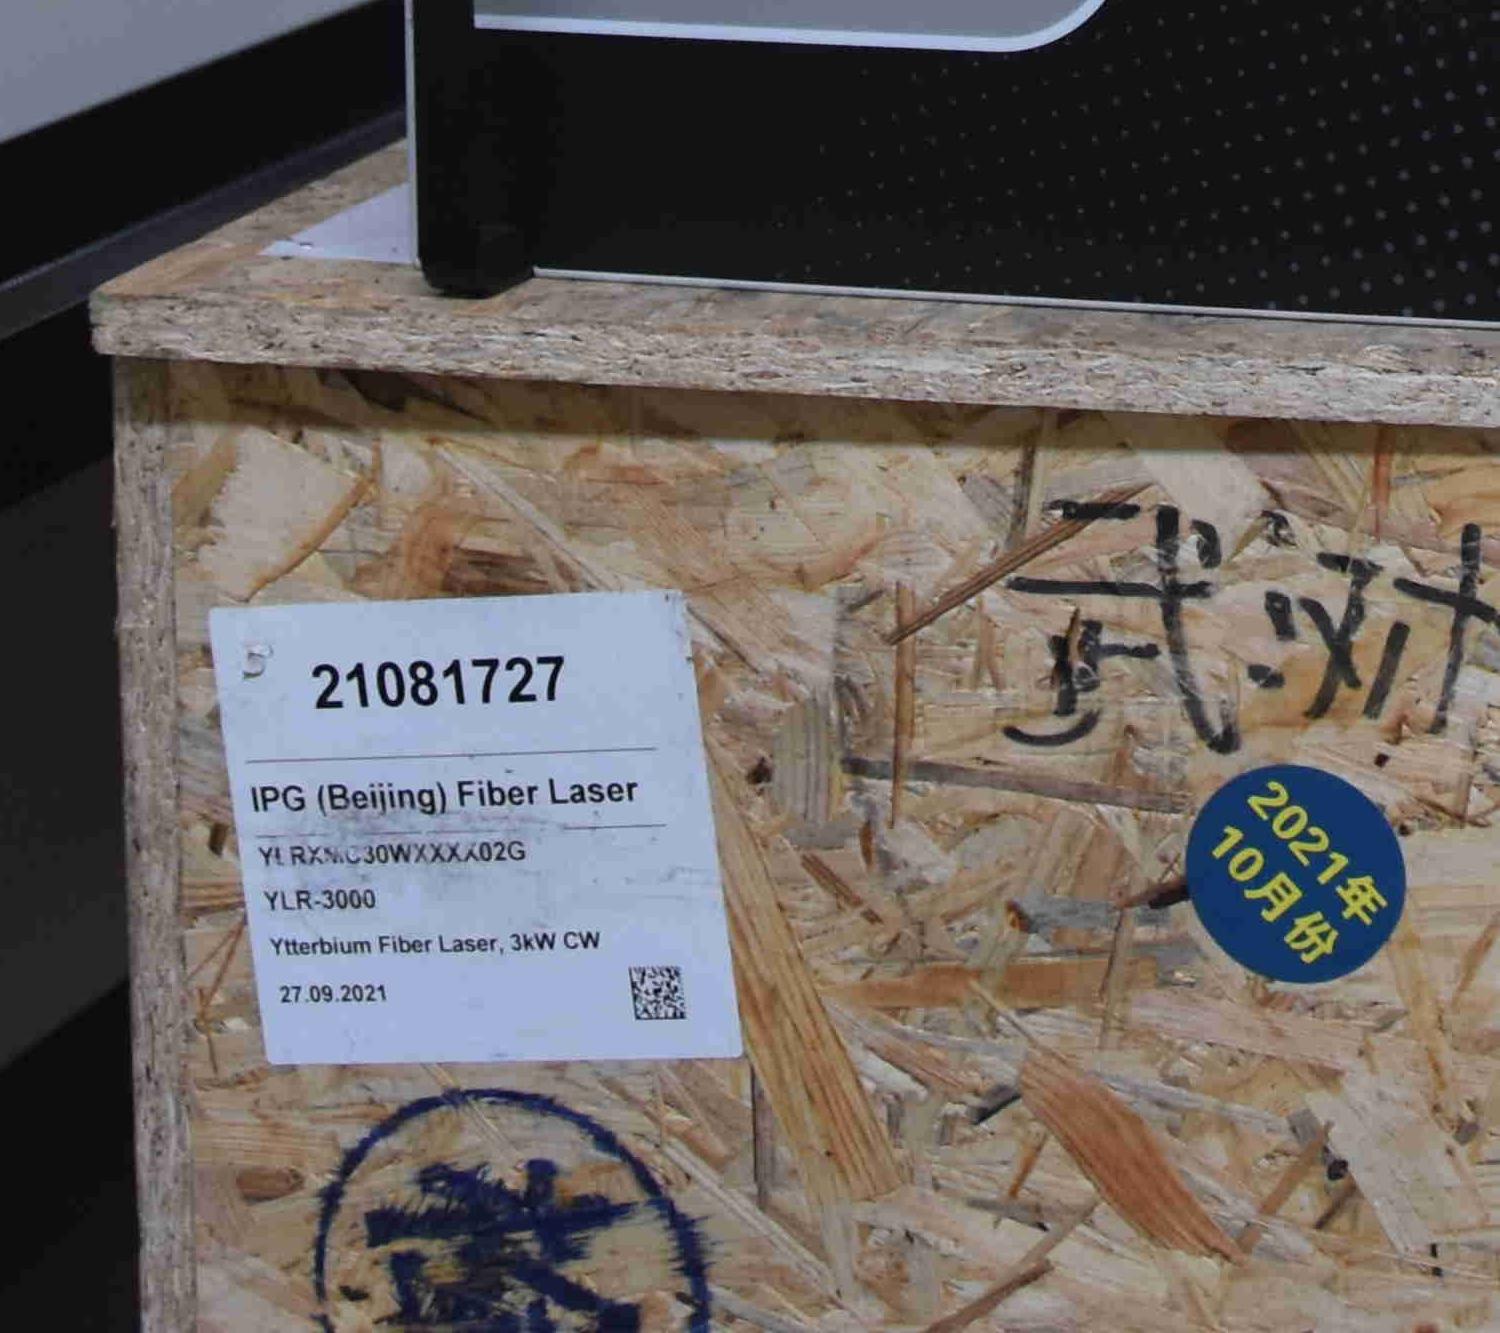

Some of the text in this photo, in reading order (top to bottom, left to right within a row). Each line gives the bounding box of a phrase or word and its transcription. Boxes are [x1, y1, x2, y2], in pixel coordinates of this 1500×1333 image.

[312, 655, 565, 710] 21081727
[251, 778, 638, 817] IPG (Beijing) Fiber Laser
[1247, 781, 1389, 927] 2021年
[264, 888, 376, 911] YLR-3000
[1209, 825, 1341, 965] 10月份
[269, 931, 600, 956] Ytterbium Fiber Laser, 3kW CW
[279, 984, 387, 1004] 27.09.2021
